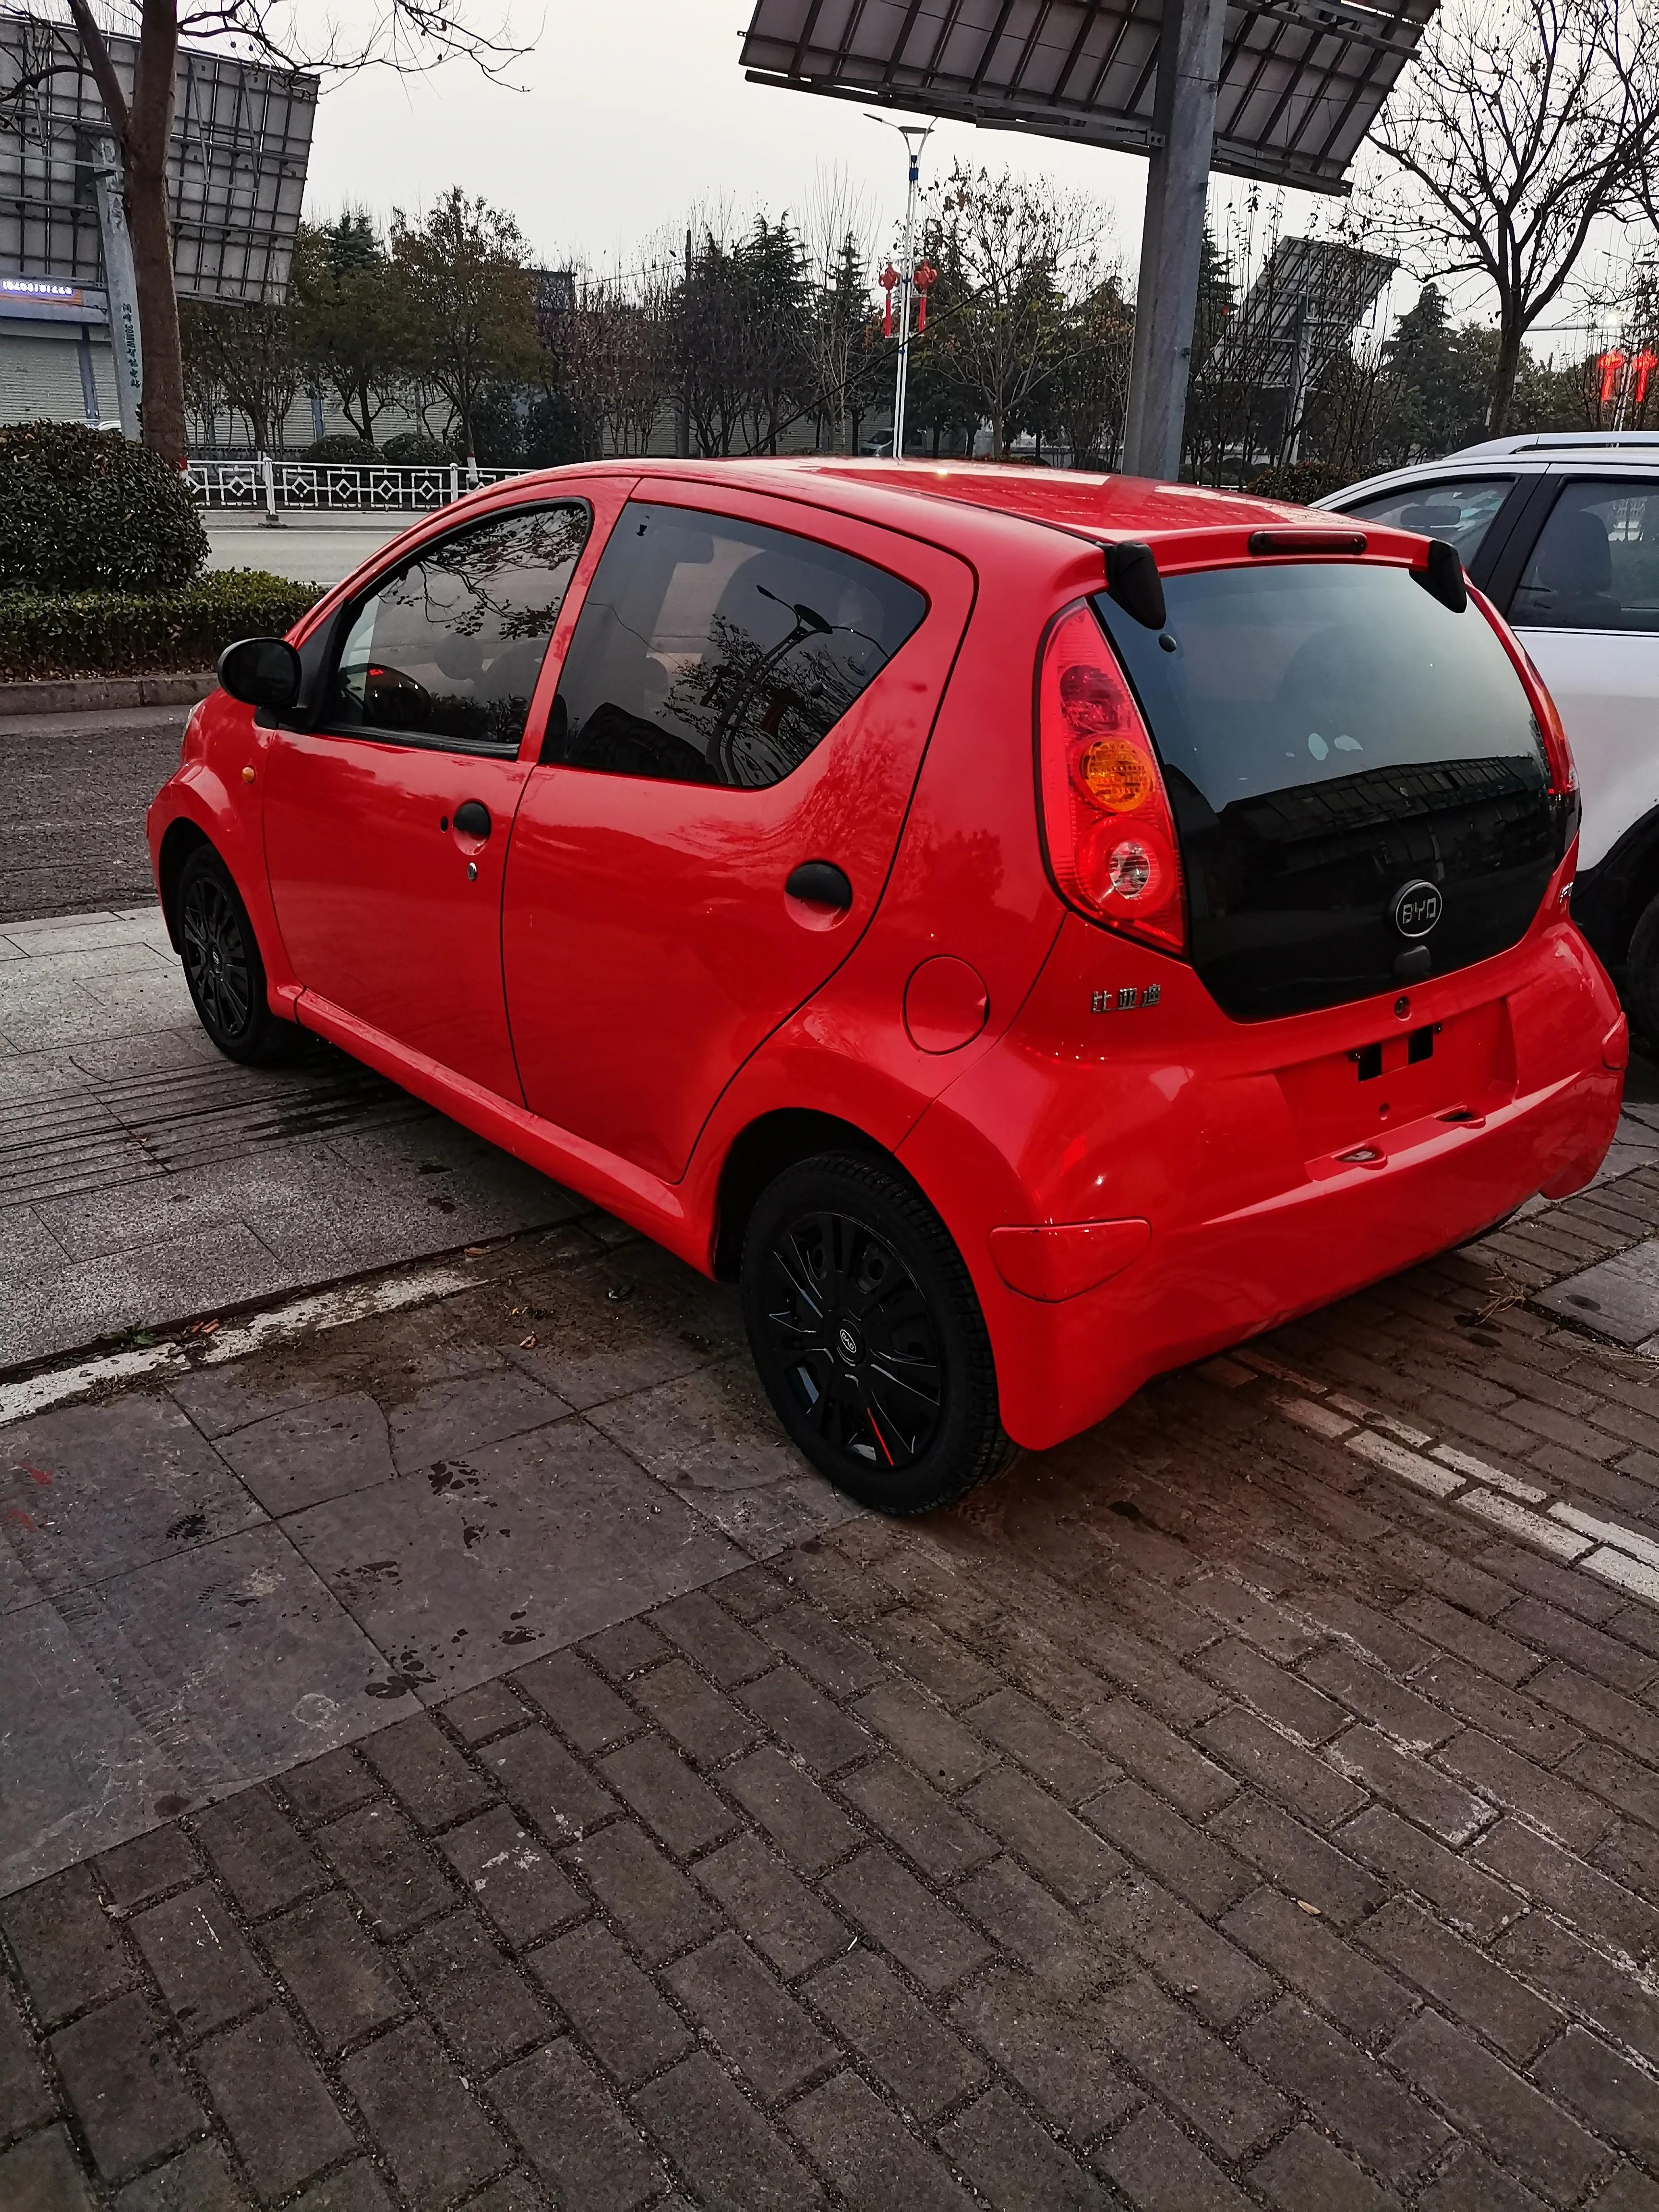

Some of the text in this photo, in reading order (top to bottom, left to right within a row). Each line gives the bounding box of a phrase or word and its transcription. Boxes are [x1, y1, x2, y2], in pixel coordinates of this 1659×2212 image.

[1402, 897, 1436, 925] BYD
[1092, 984, 1161, 1013] 比亚迪
